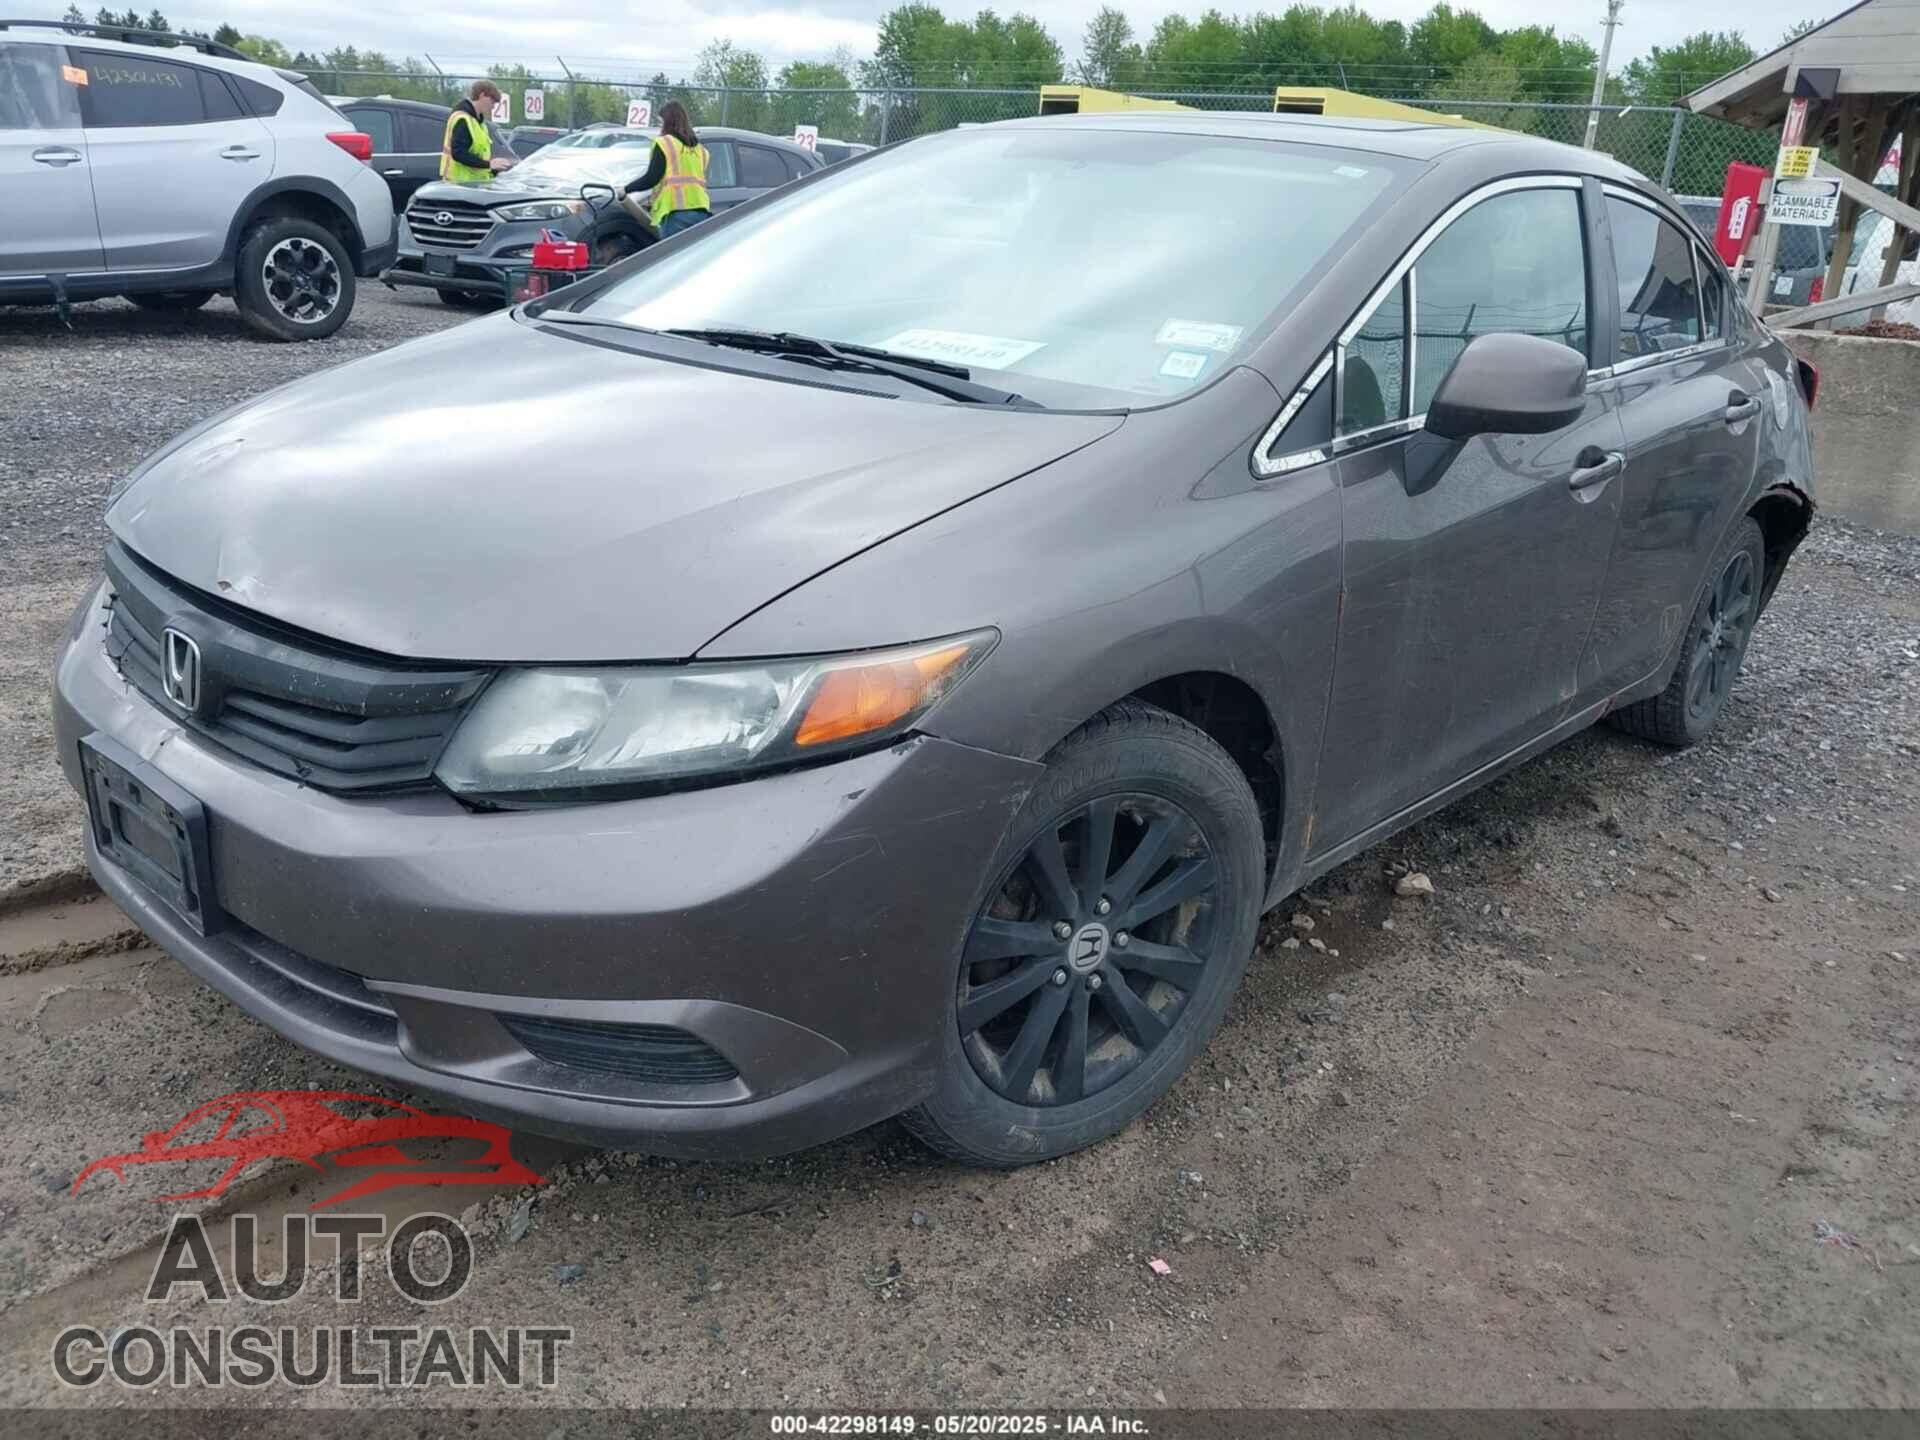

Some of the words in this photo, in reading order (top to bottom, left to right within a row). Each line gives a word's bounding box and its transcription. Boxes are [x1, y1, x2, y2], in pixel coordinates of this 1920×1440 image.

[493, 98, 508, 118] 21
[526, 96, 542, 114] 20
[629, 107, 648, 126] 22
[1772, 195, 1835, 209] FLAMMABLE
[1772, 207, 1829, 220] MATERIALS
